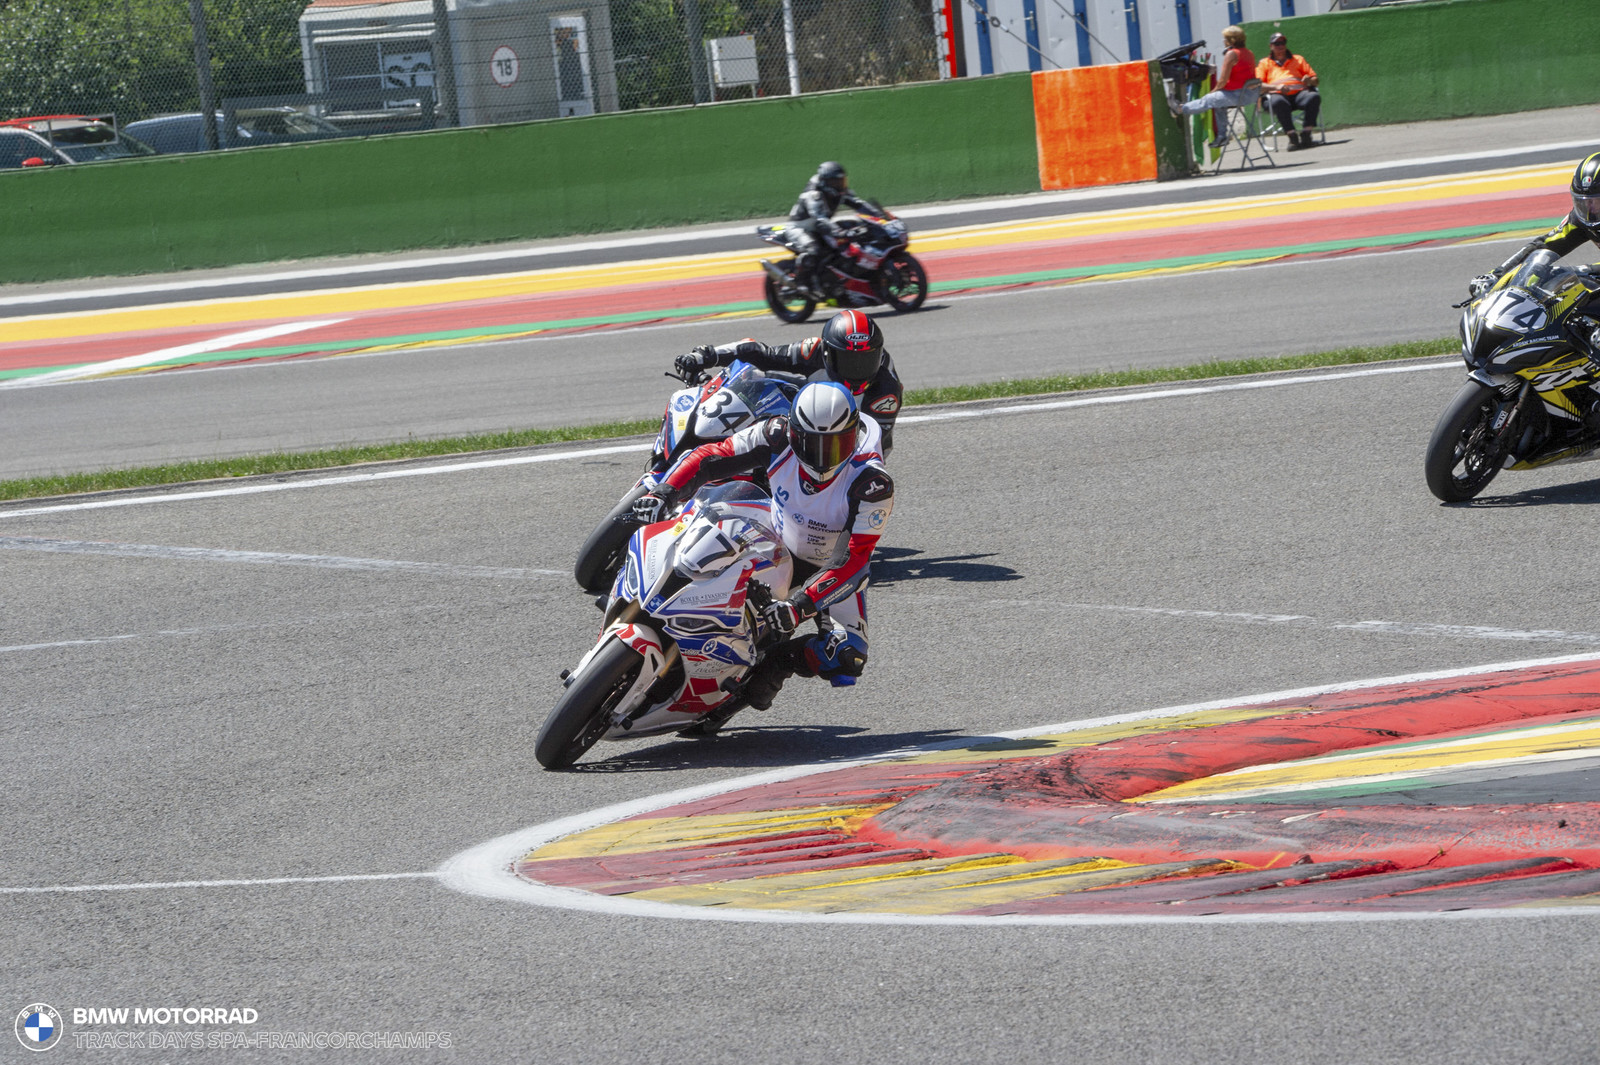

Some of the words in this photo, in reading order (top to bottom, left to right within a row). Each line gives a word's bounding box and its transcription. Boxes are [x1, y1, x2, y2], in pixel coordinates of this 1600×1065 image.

[496, 59, 513, 77] 18
[701, 391, 751, 434] 34
[808, 518, 828, 529] BMW
[704, 591, 728, 600] EVASION
